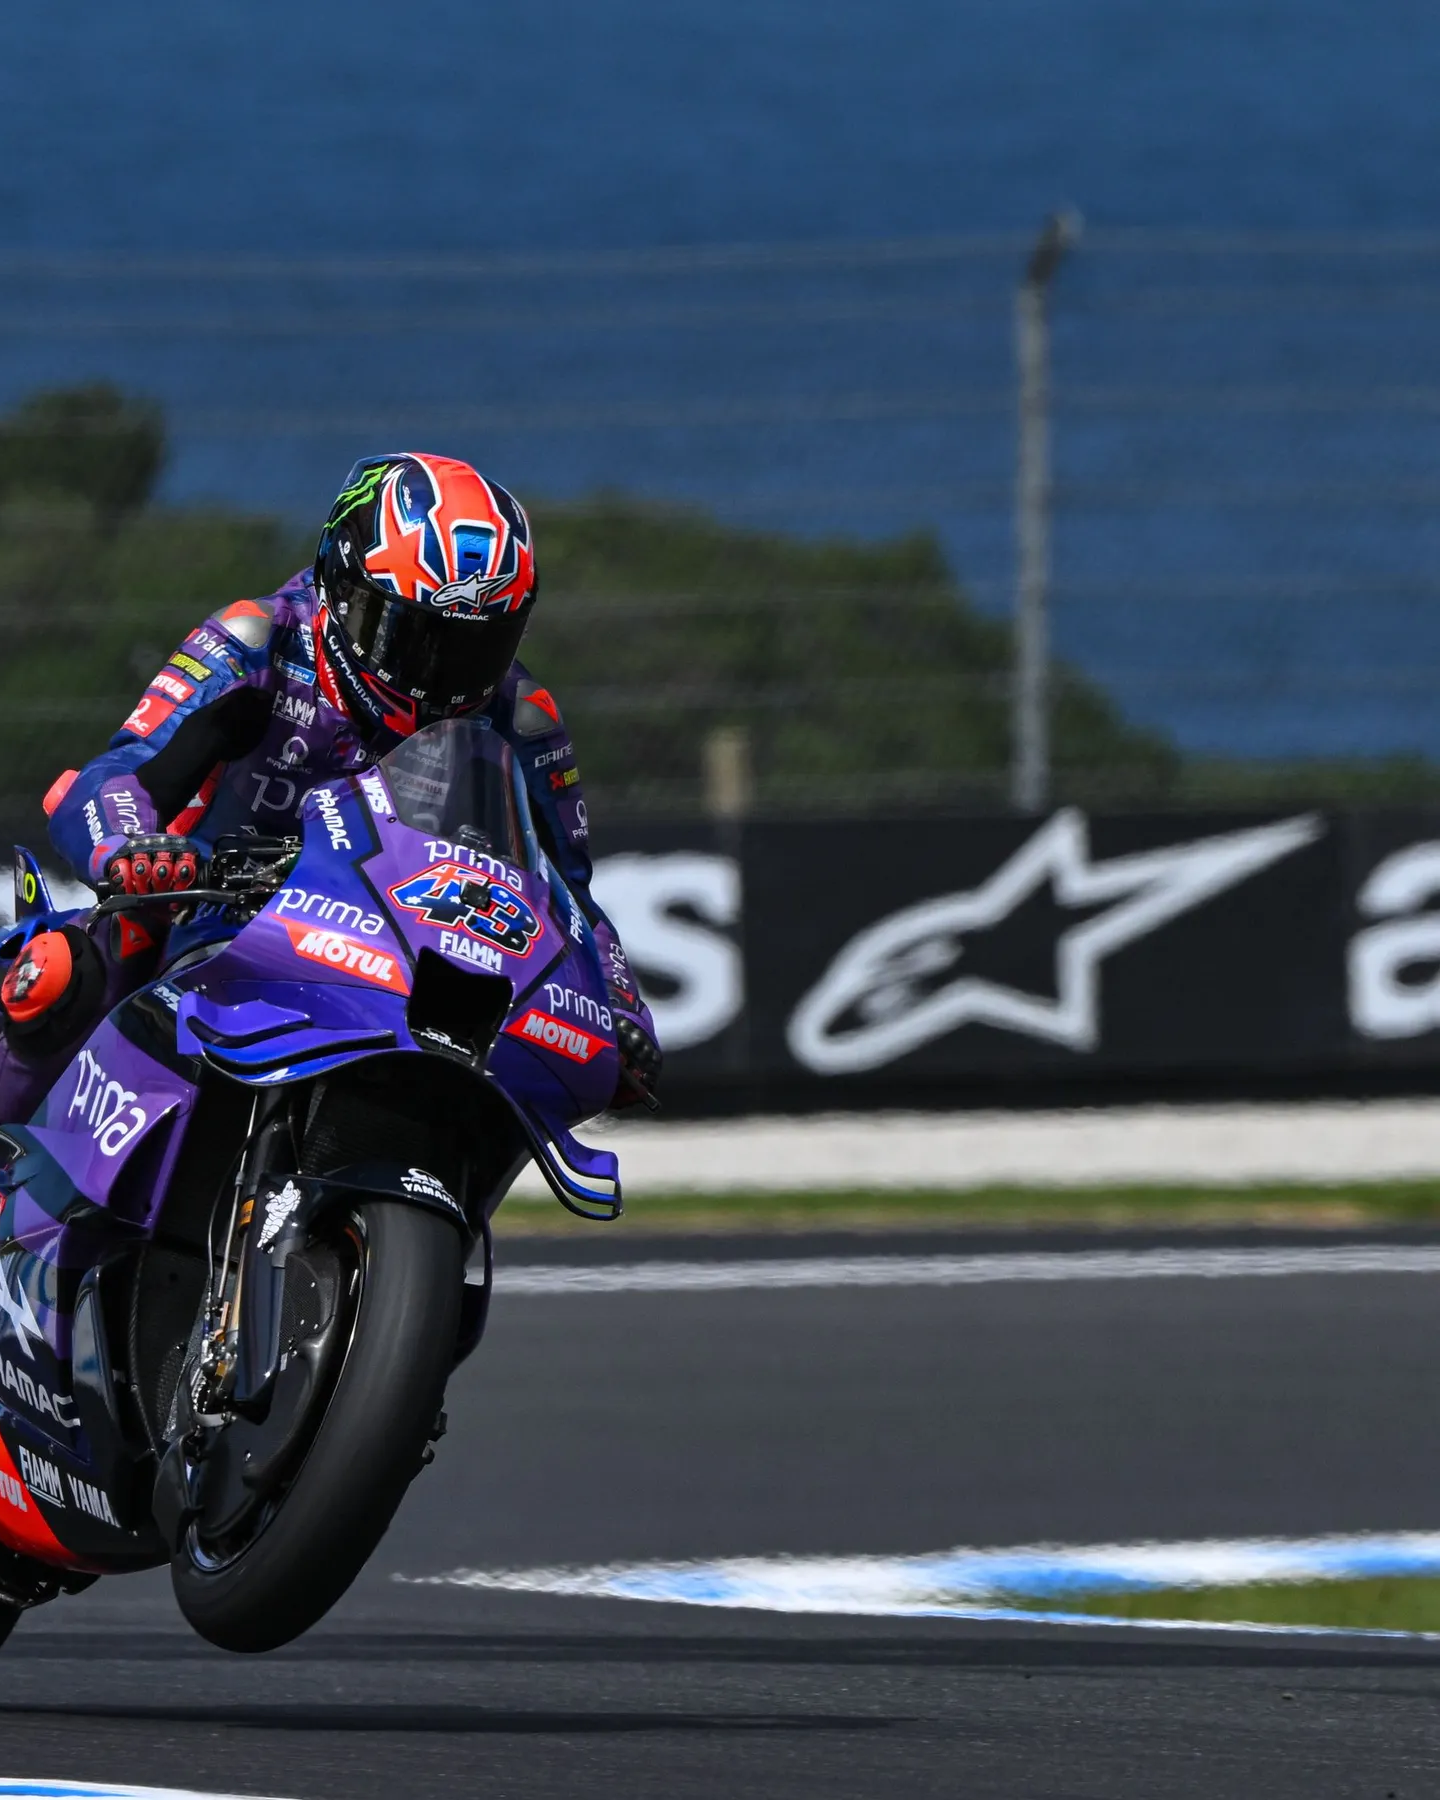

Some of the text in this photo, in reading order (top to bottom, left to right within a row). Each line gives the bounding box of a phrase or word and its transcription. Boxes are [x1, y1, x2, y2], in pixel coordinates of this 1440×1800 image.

[452, 611, 489, 621] PRAMAC
[351, 642, 365, 657] CAT
[150, 675, 188, 701] OTUL
[377, 669, 393, 682] CAT
[410, 688, 426, 699] CAT
[312, 789, 351, 850] PRAMAC
[423, 840, 523, 892] prima
[279, 887, 385, 935] prima
[388, 861, 544, 958] 43
[297, 932, 395, 982] MOTUL
[440, 931, 503, 972] FIAMM
[544, 982, 612, 1031] prima
[522, 1014, 589, 1060] MOTUL
[68, 1050, 146, 1157] prima
[403, 1183, 459, 1212] YAMAHA
[19, 1445, 64, 1503] FIAMM
[67, 1473, 121, 1528] YAMA
